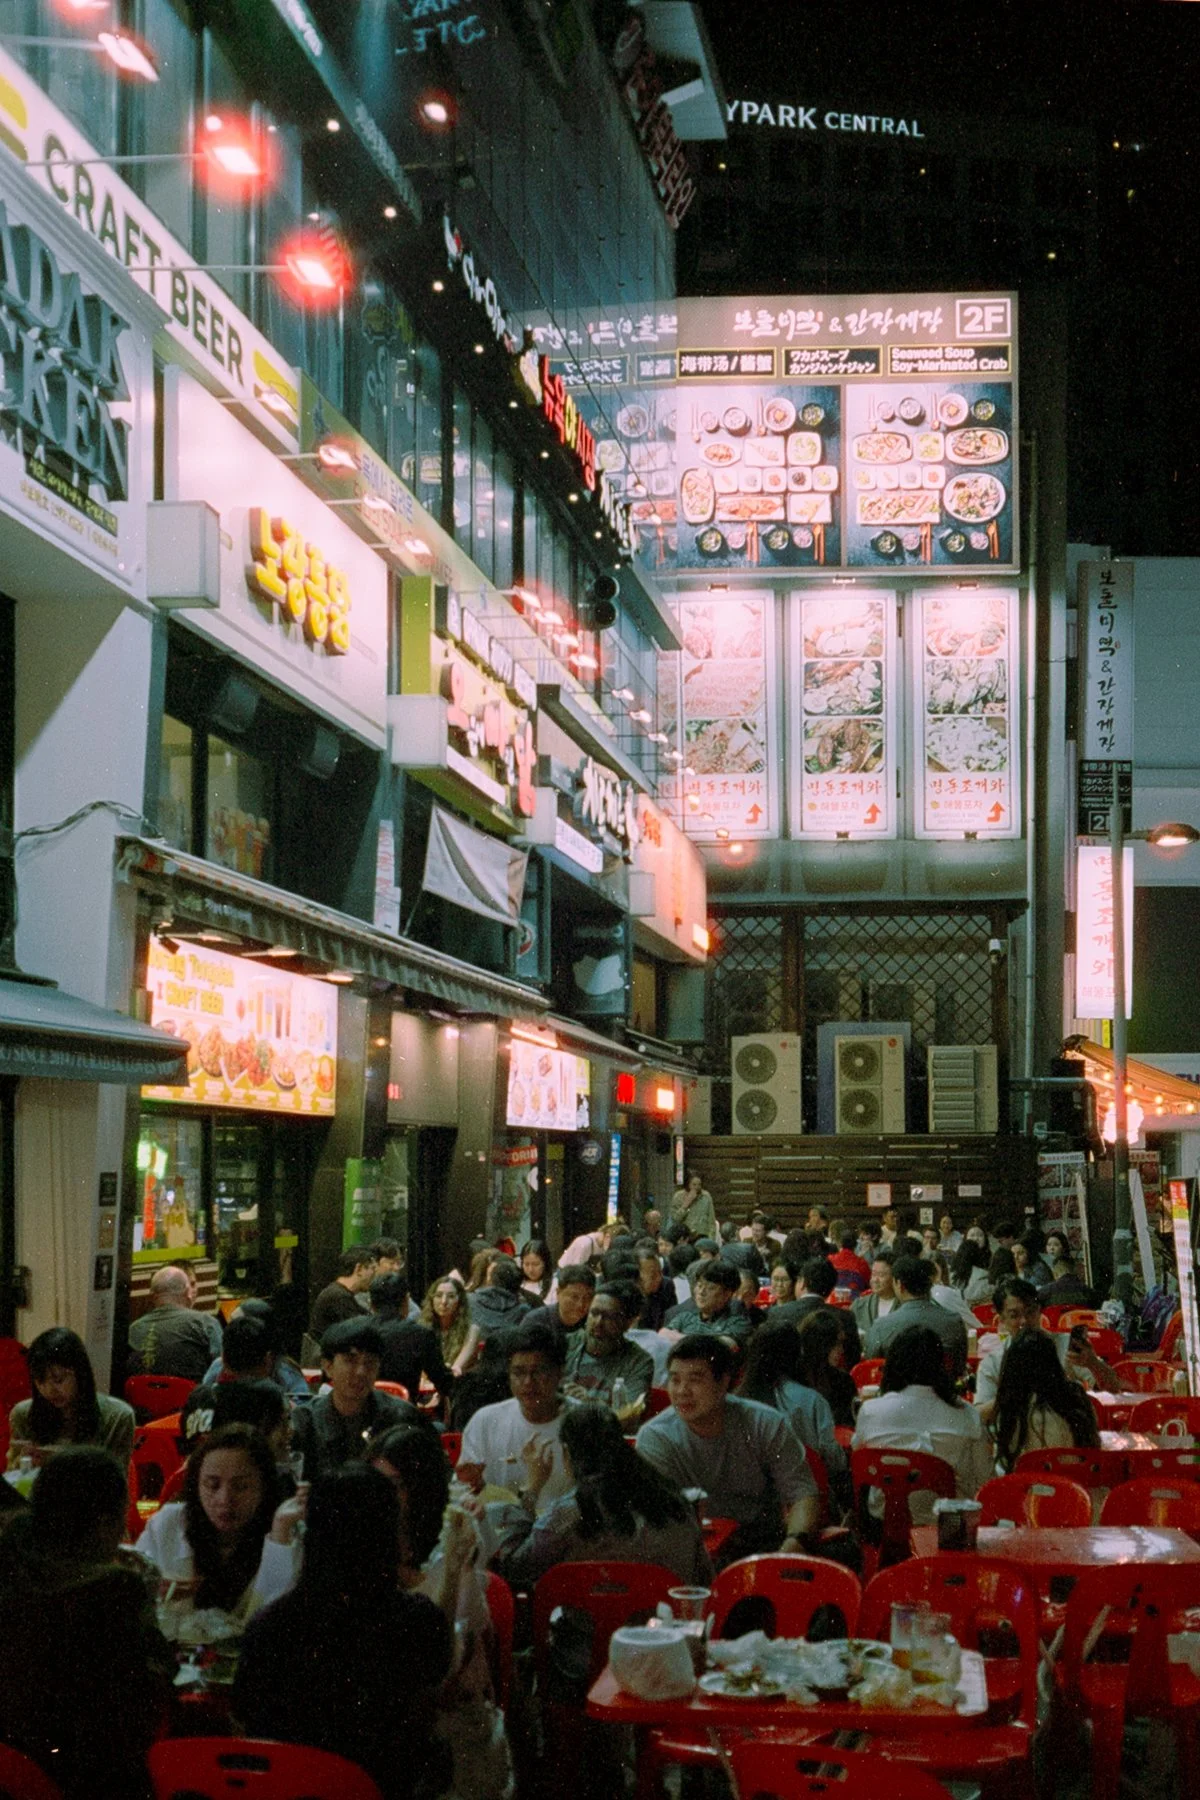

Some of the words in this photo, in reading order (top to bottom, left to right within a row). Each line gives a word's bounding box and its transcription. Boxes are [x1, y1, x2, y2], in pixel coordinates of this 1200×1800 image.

[824, 112, 926, 137] CENTRAL
[44, 130, 161, 297] CRAFT
[171, 260, 245, 388] BEER
[828, 316, 843, 333] &
[844, 306, 944, 337] 간장게장
[962, 305, 1006, 333] 2F
[789, 349, 850, 363] ワカメスープ
[891, 347, 943, 360] Seaweed
[944, 347, 975, 360] Soup
[891, 359, 977, 374] Soy-Marinated
[978, 358, 1008, 371] Crab
[1096, 570, 1118, 658] 보돌미역
[1100, 659, 1113, 673] &
[1096, 677, 1117, 754] 간장게장
[807, 779, 883, 796] 명동조개와
[930, 777, 1005, 795] 명동조개와
